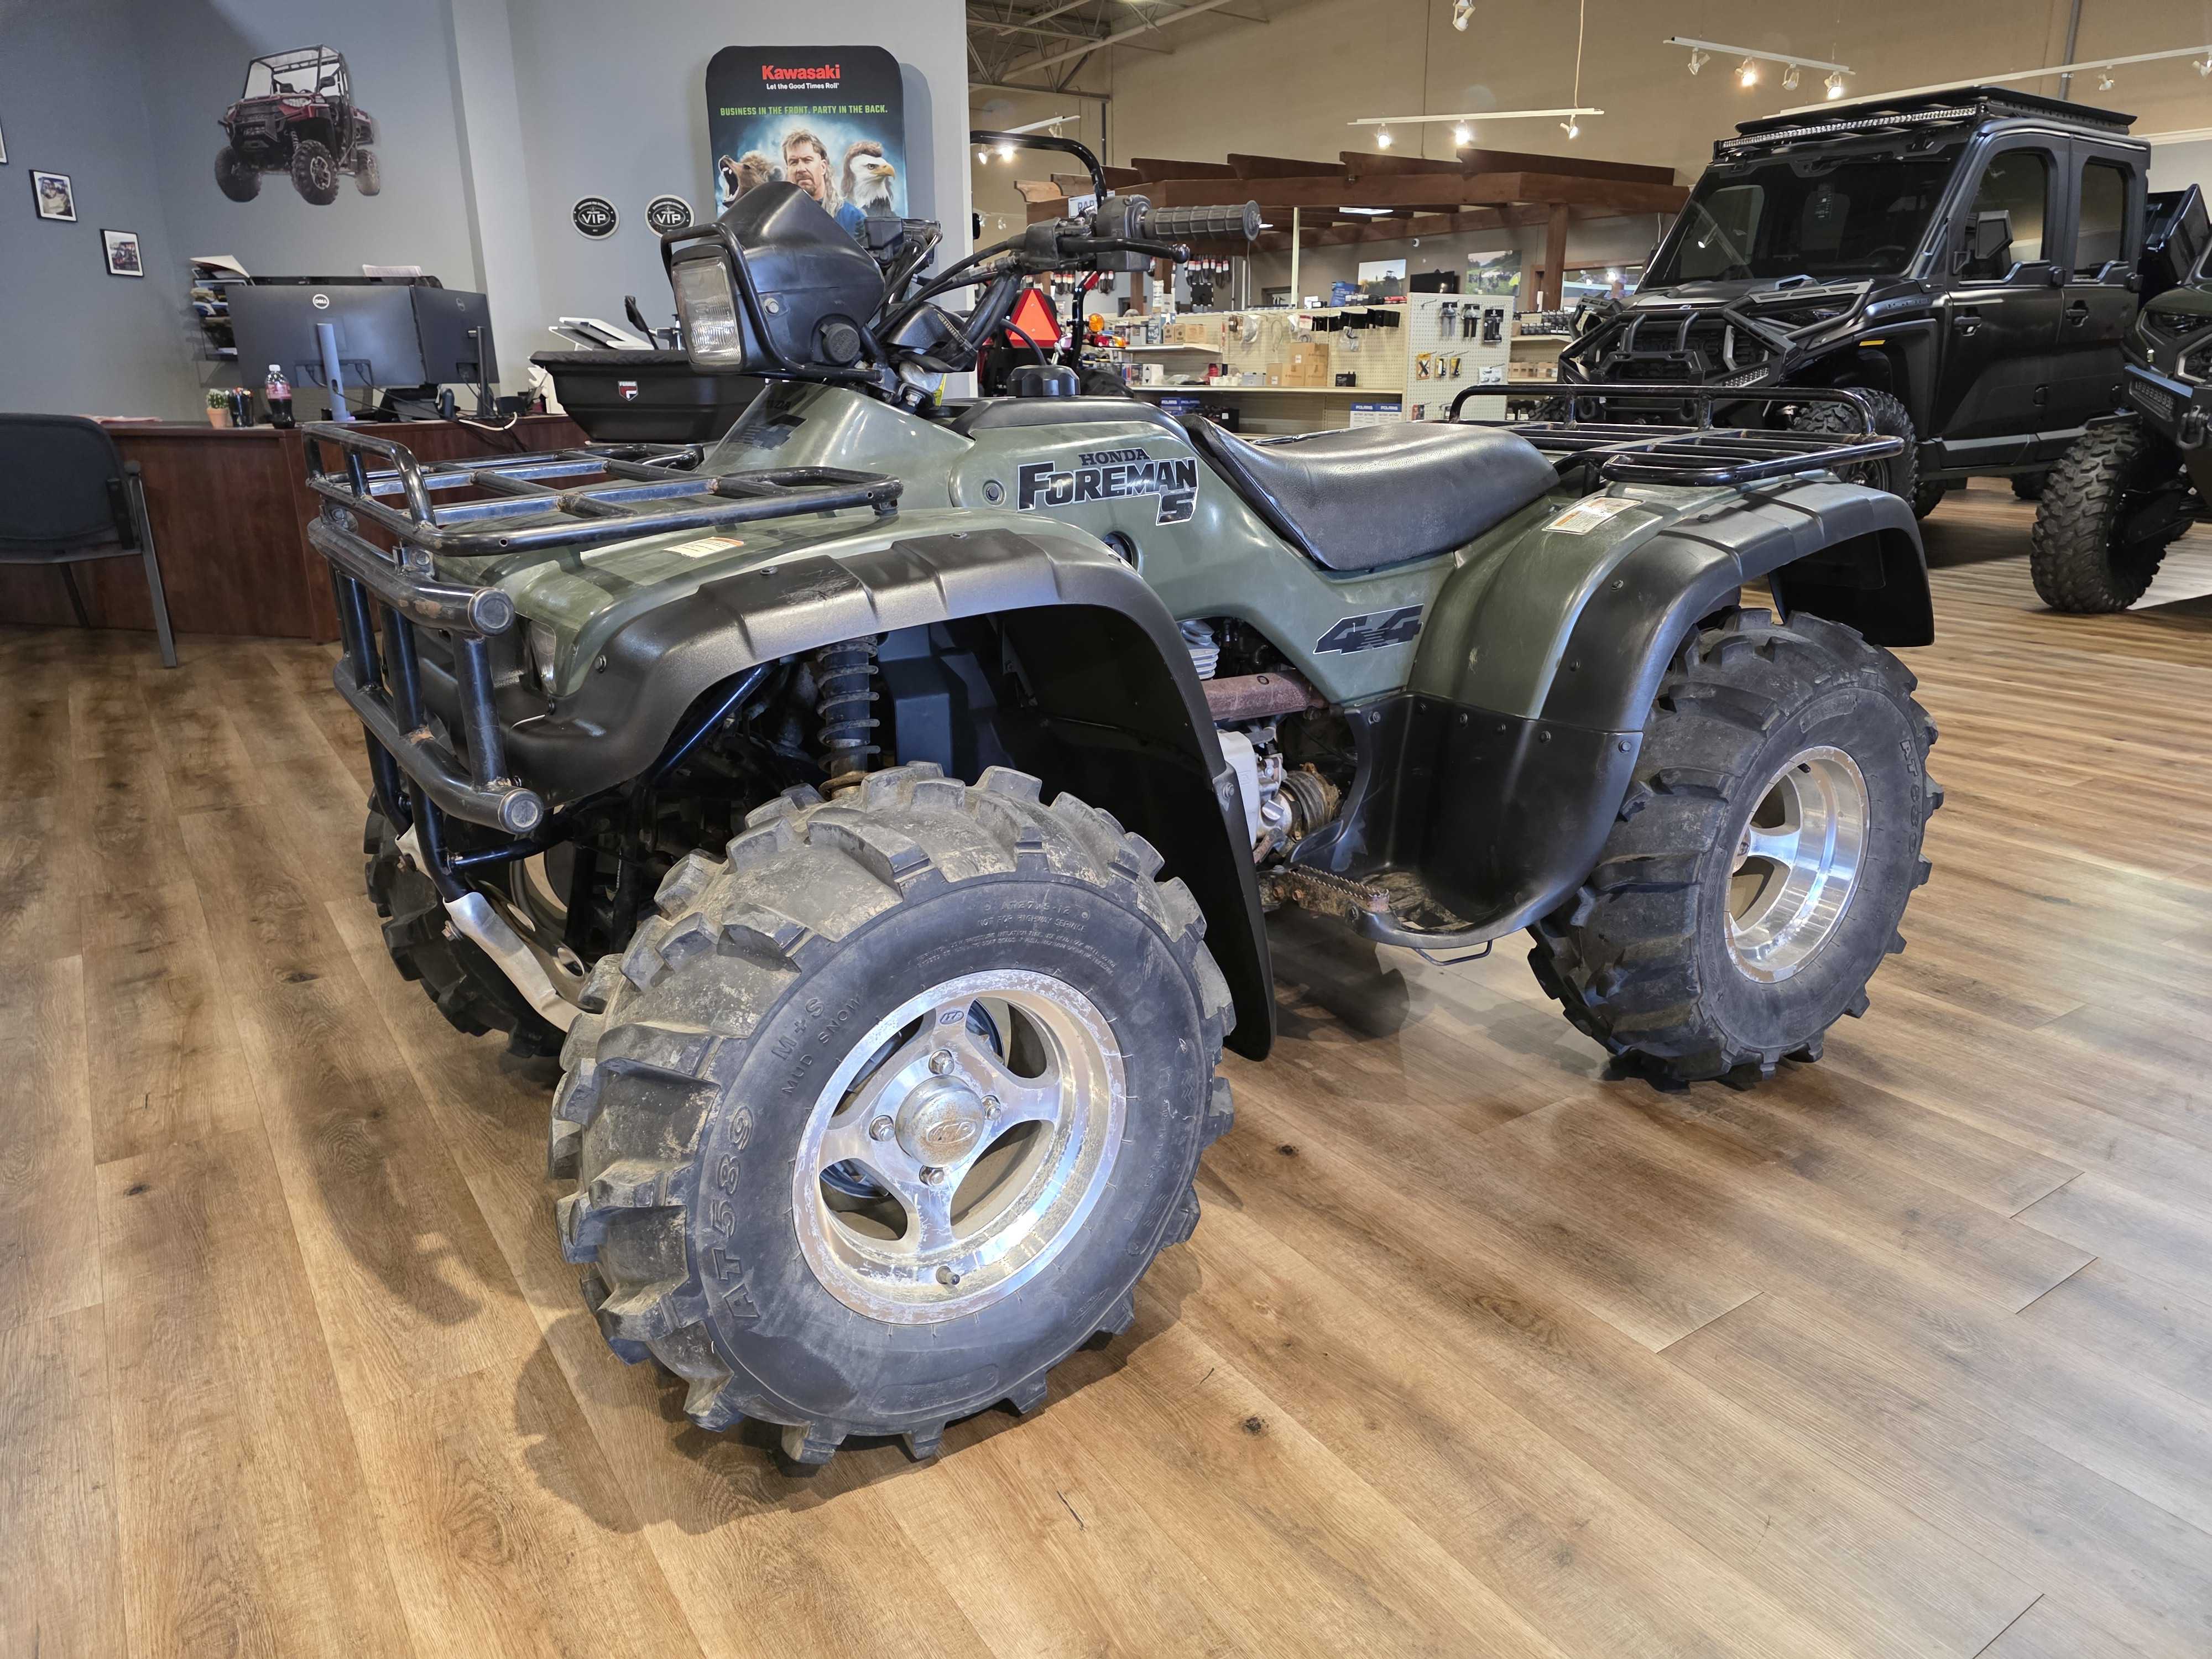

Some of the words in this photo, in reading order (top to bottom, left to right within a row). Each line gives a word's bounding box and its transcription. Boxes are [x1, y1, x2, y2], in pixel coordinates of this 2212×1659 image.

[762, 64, 840, 80] Kawasaki
[720, 107, 757, 116] BUSINESS
[785, 106, 811, 114] FRONT.
[813, 106, 837, 114] PARTY
[839, 105, 847, 113] IN
[865, 105, 888, 113] BACK.
[582, 214, 606, 223] VIP
[656, 214, 681, 223] VIP
[1079, 448, 1151, 466] HONDA
[1018, 458, 1198, 512] FOREMAN
[978, 916, 994, 926] NOT
[1017, 914, 1052, 924] HIGHWAY
[1054, 918, 1087, 933] SERVICE
[781, 1054, 813, 1093] MUD
[818, 995, 861, 1044] SNOW
[711, 1105, 761, 1317] AT589
